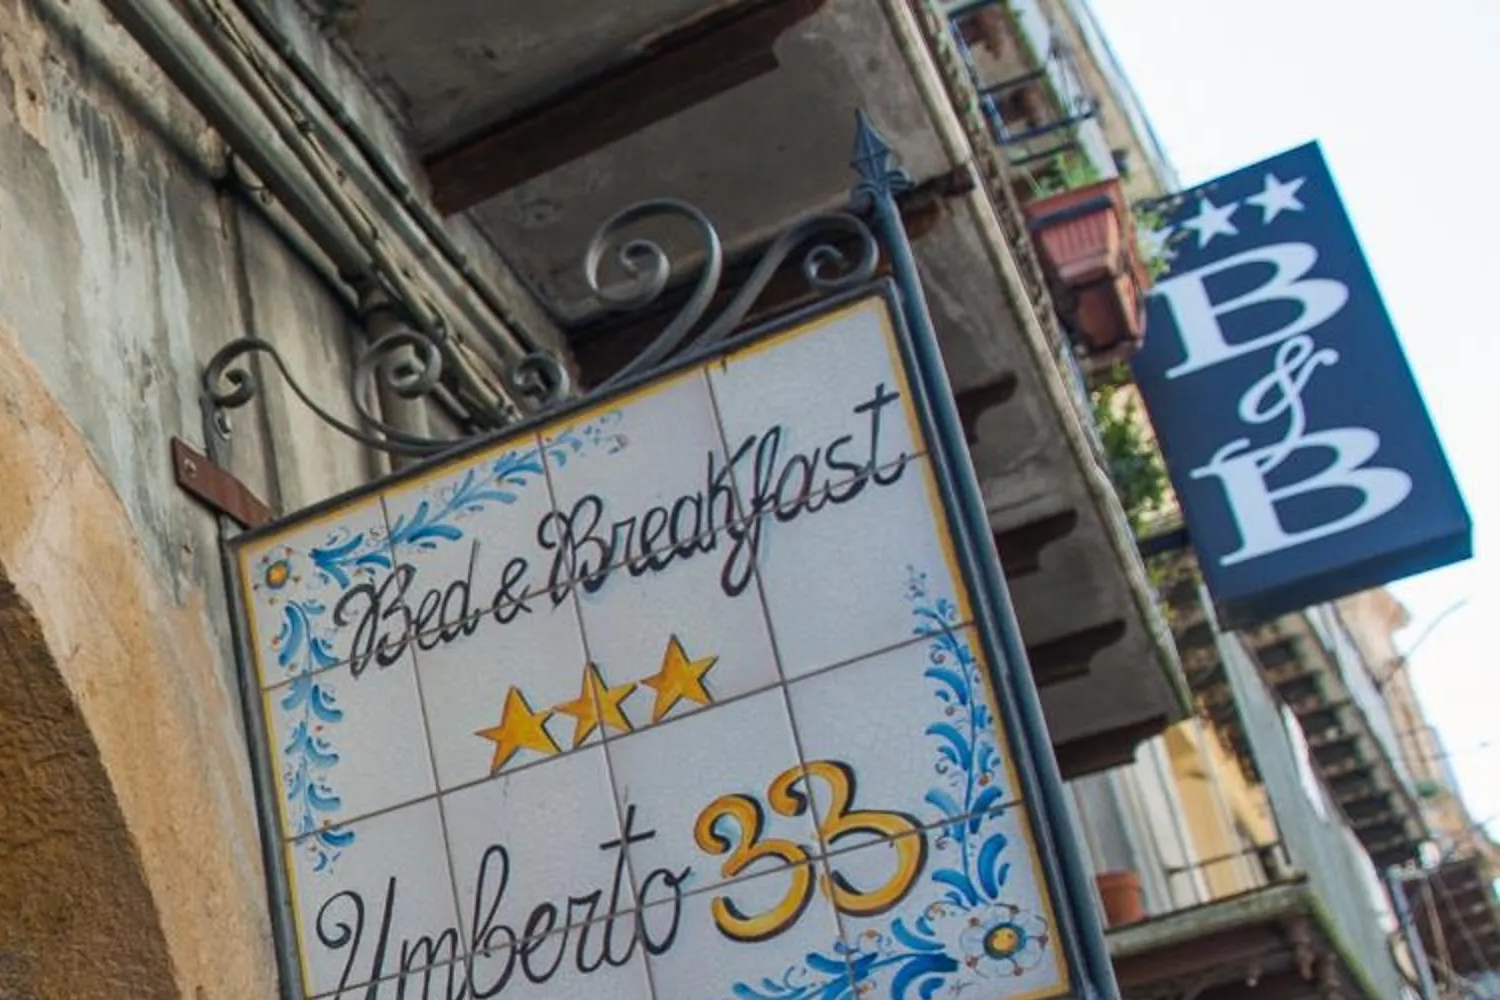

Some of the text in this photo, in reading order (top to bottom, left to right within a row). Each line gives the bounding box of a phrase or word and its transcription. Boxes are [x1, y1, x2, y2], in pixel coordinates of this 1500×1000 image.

[333, 539, 481, 680] Bed
[498, 557, 533, 624] &
[695, 760, 927, 943] 33
